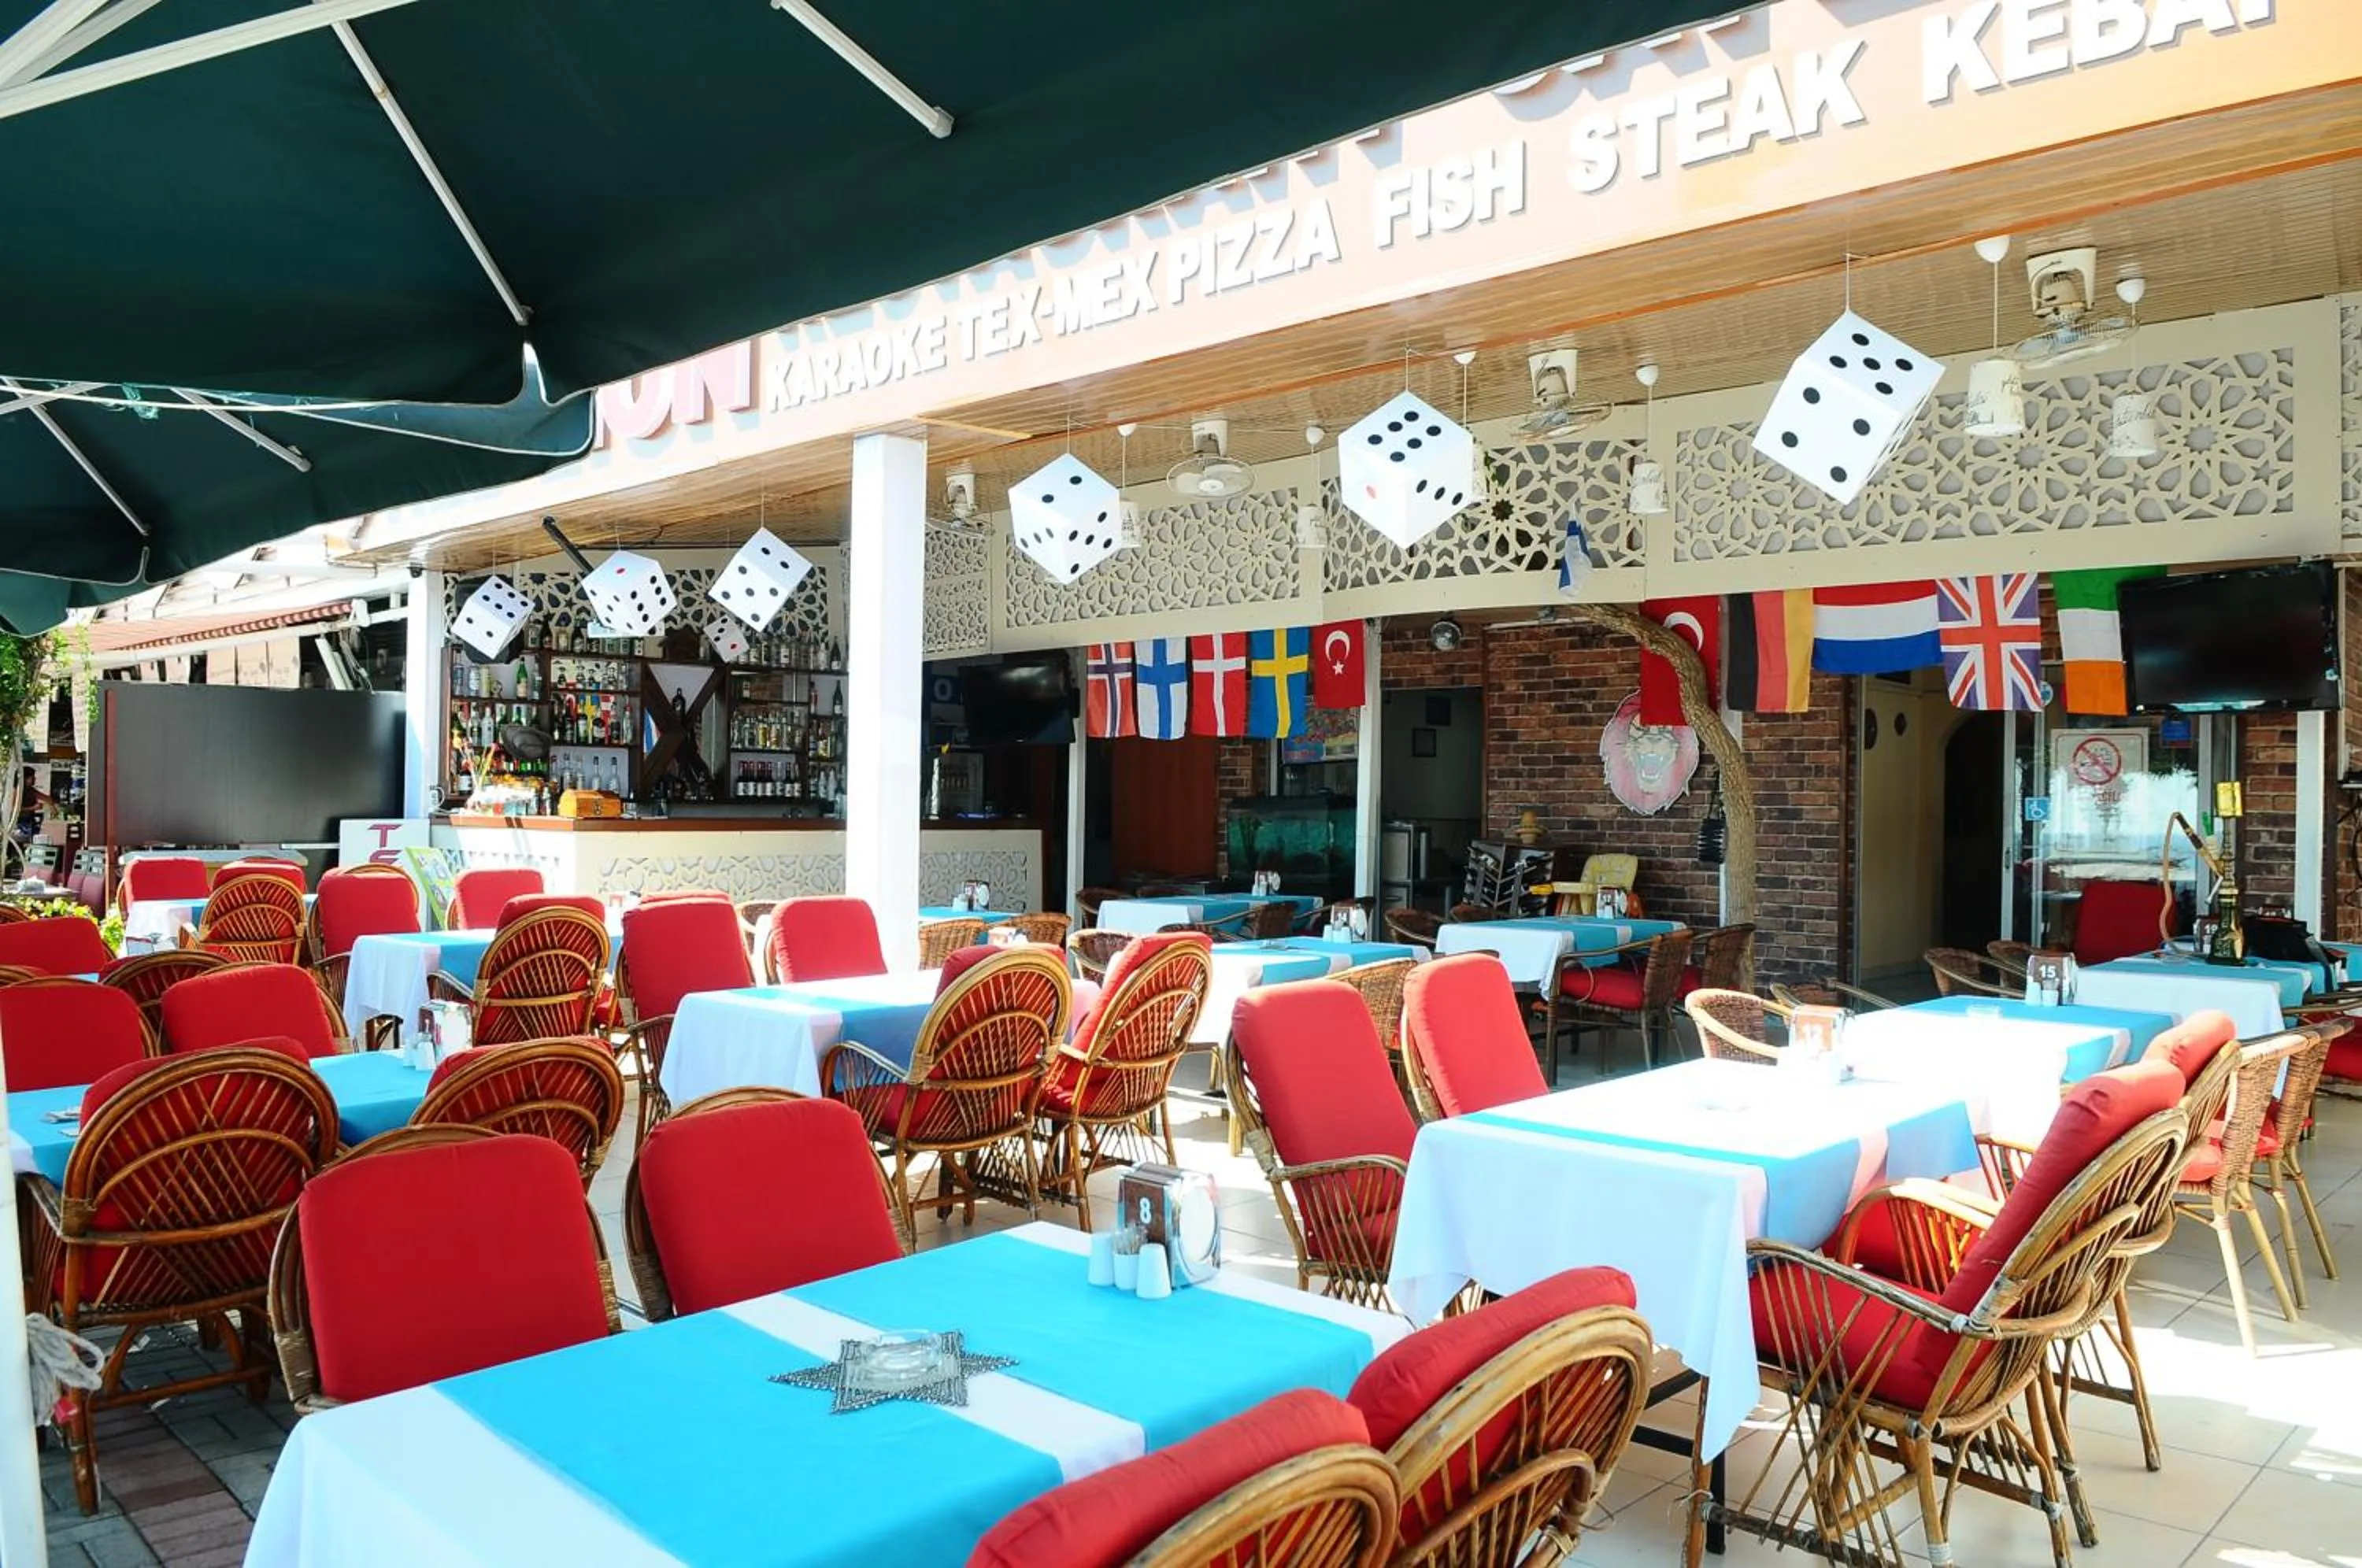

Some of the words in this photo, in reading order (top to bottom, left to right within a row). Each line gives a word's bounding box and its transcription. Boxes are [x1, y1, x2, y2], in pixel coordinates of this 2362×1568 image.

[769, 316, 947, 412] KARAOKE
[956, 251, 1160, 361] TEX-MEX
[1167, 199, 1342, 305] PIZZA
[1372, 139, 1527, 250] FISH
[1567, 40, 1868, 194] STEAK
[2039, 964, 2056, 978] 15
[1139, 1196, 1152, 1224] 8
